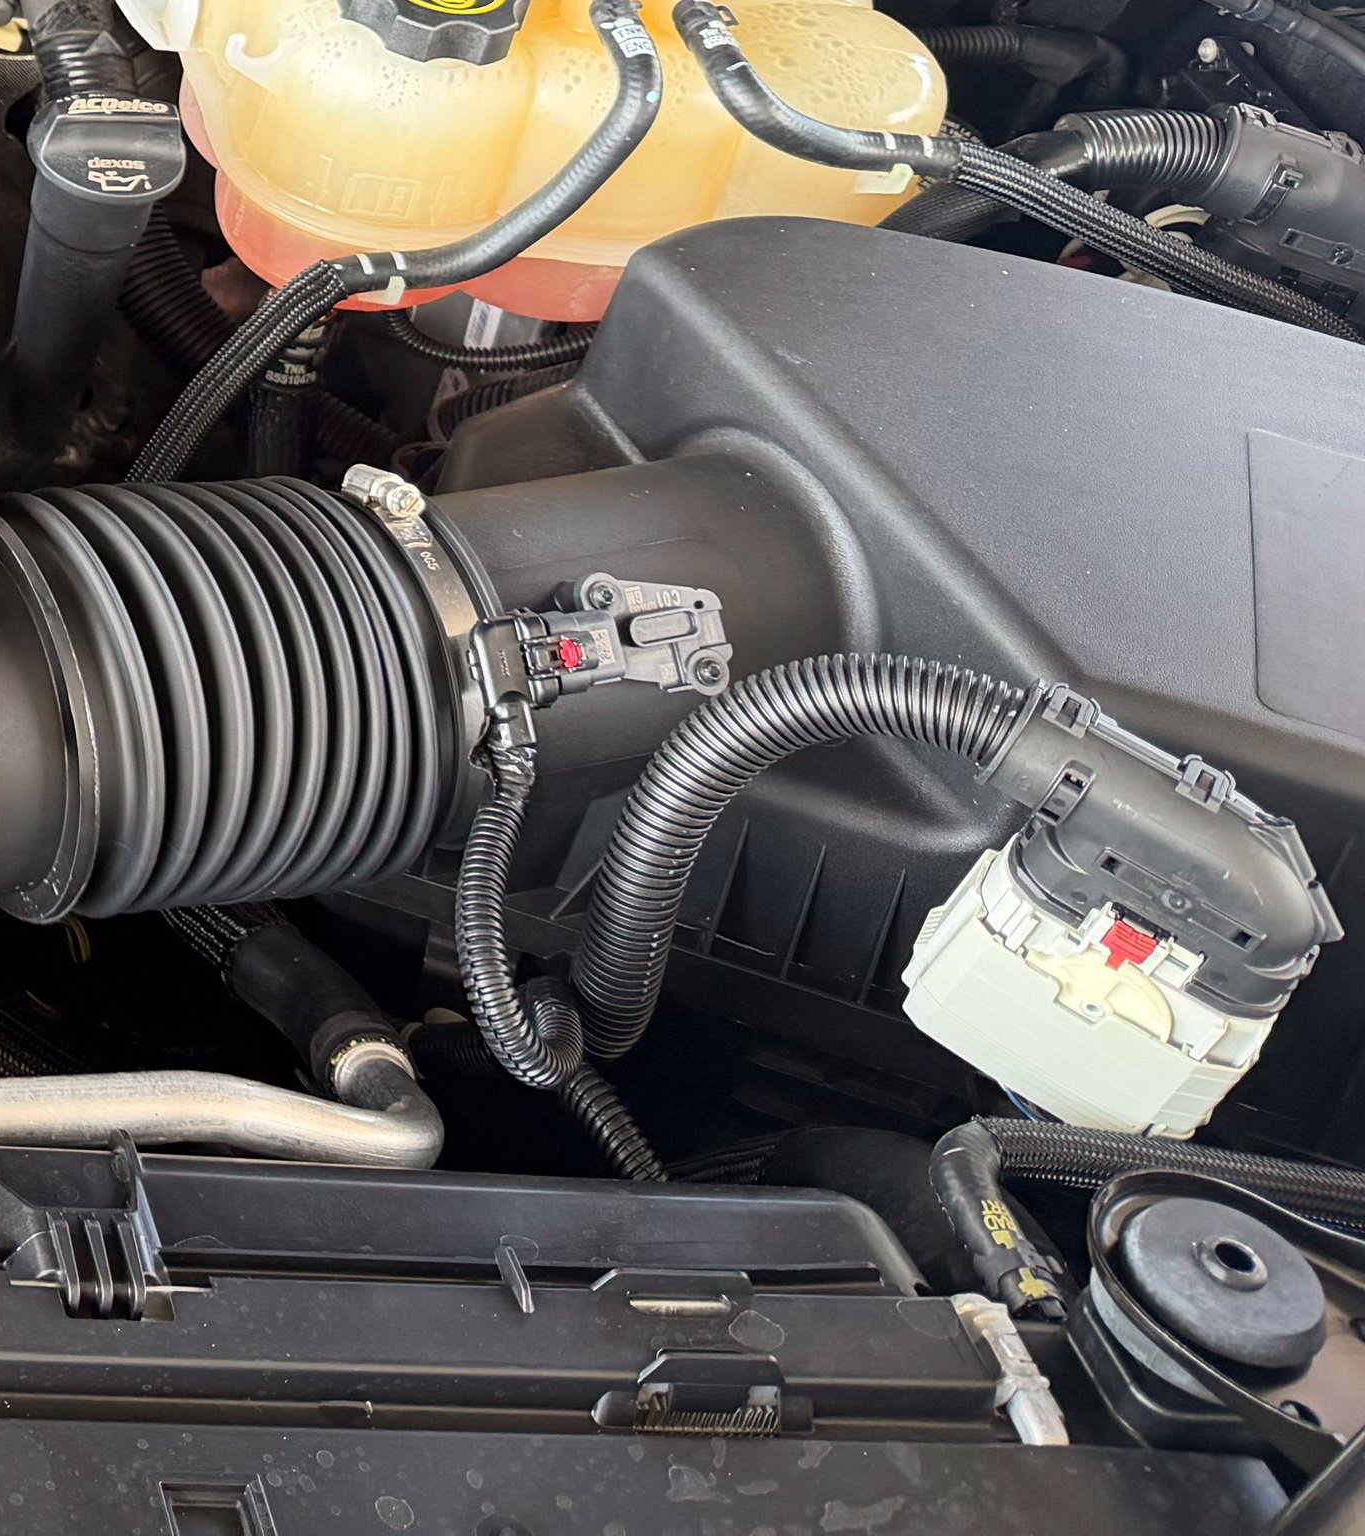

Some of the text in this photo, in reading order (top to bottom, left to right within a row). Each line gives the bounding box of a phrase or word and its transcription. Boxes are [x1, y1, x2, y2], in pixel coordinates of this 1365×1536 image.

[68, 98, 169, 114] ACDelco
[87, 157, 146, 170] dexos
[983, 1214, 1018, 1232] RAD
